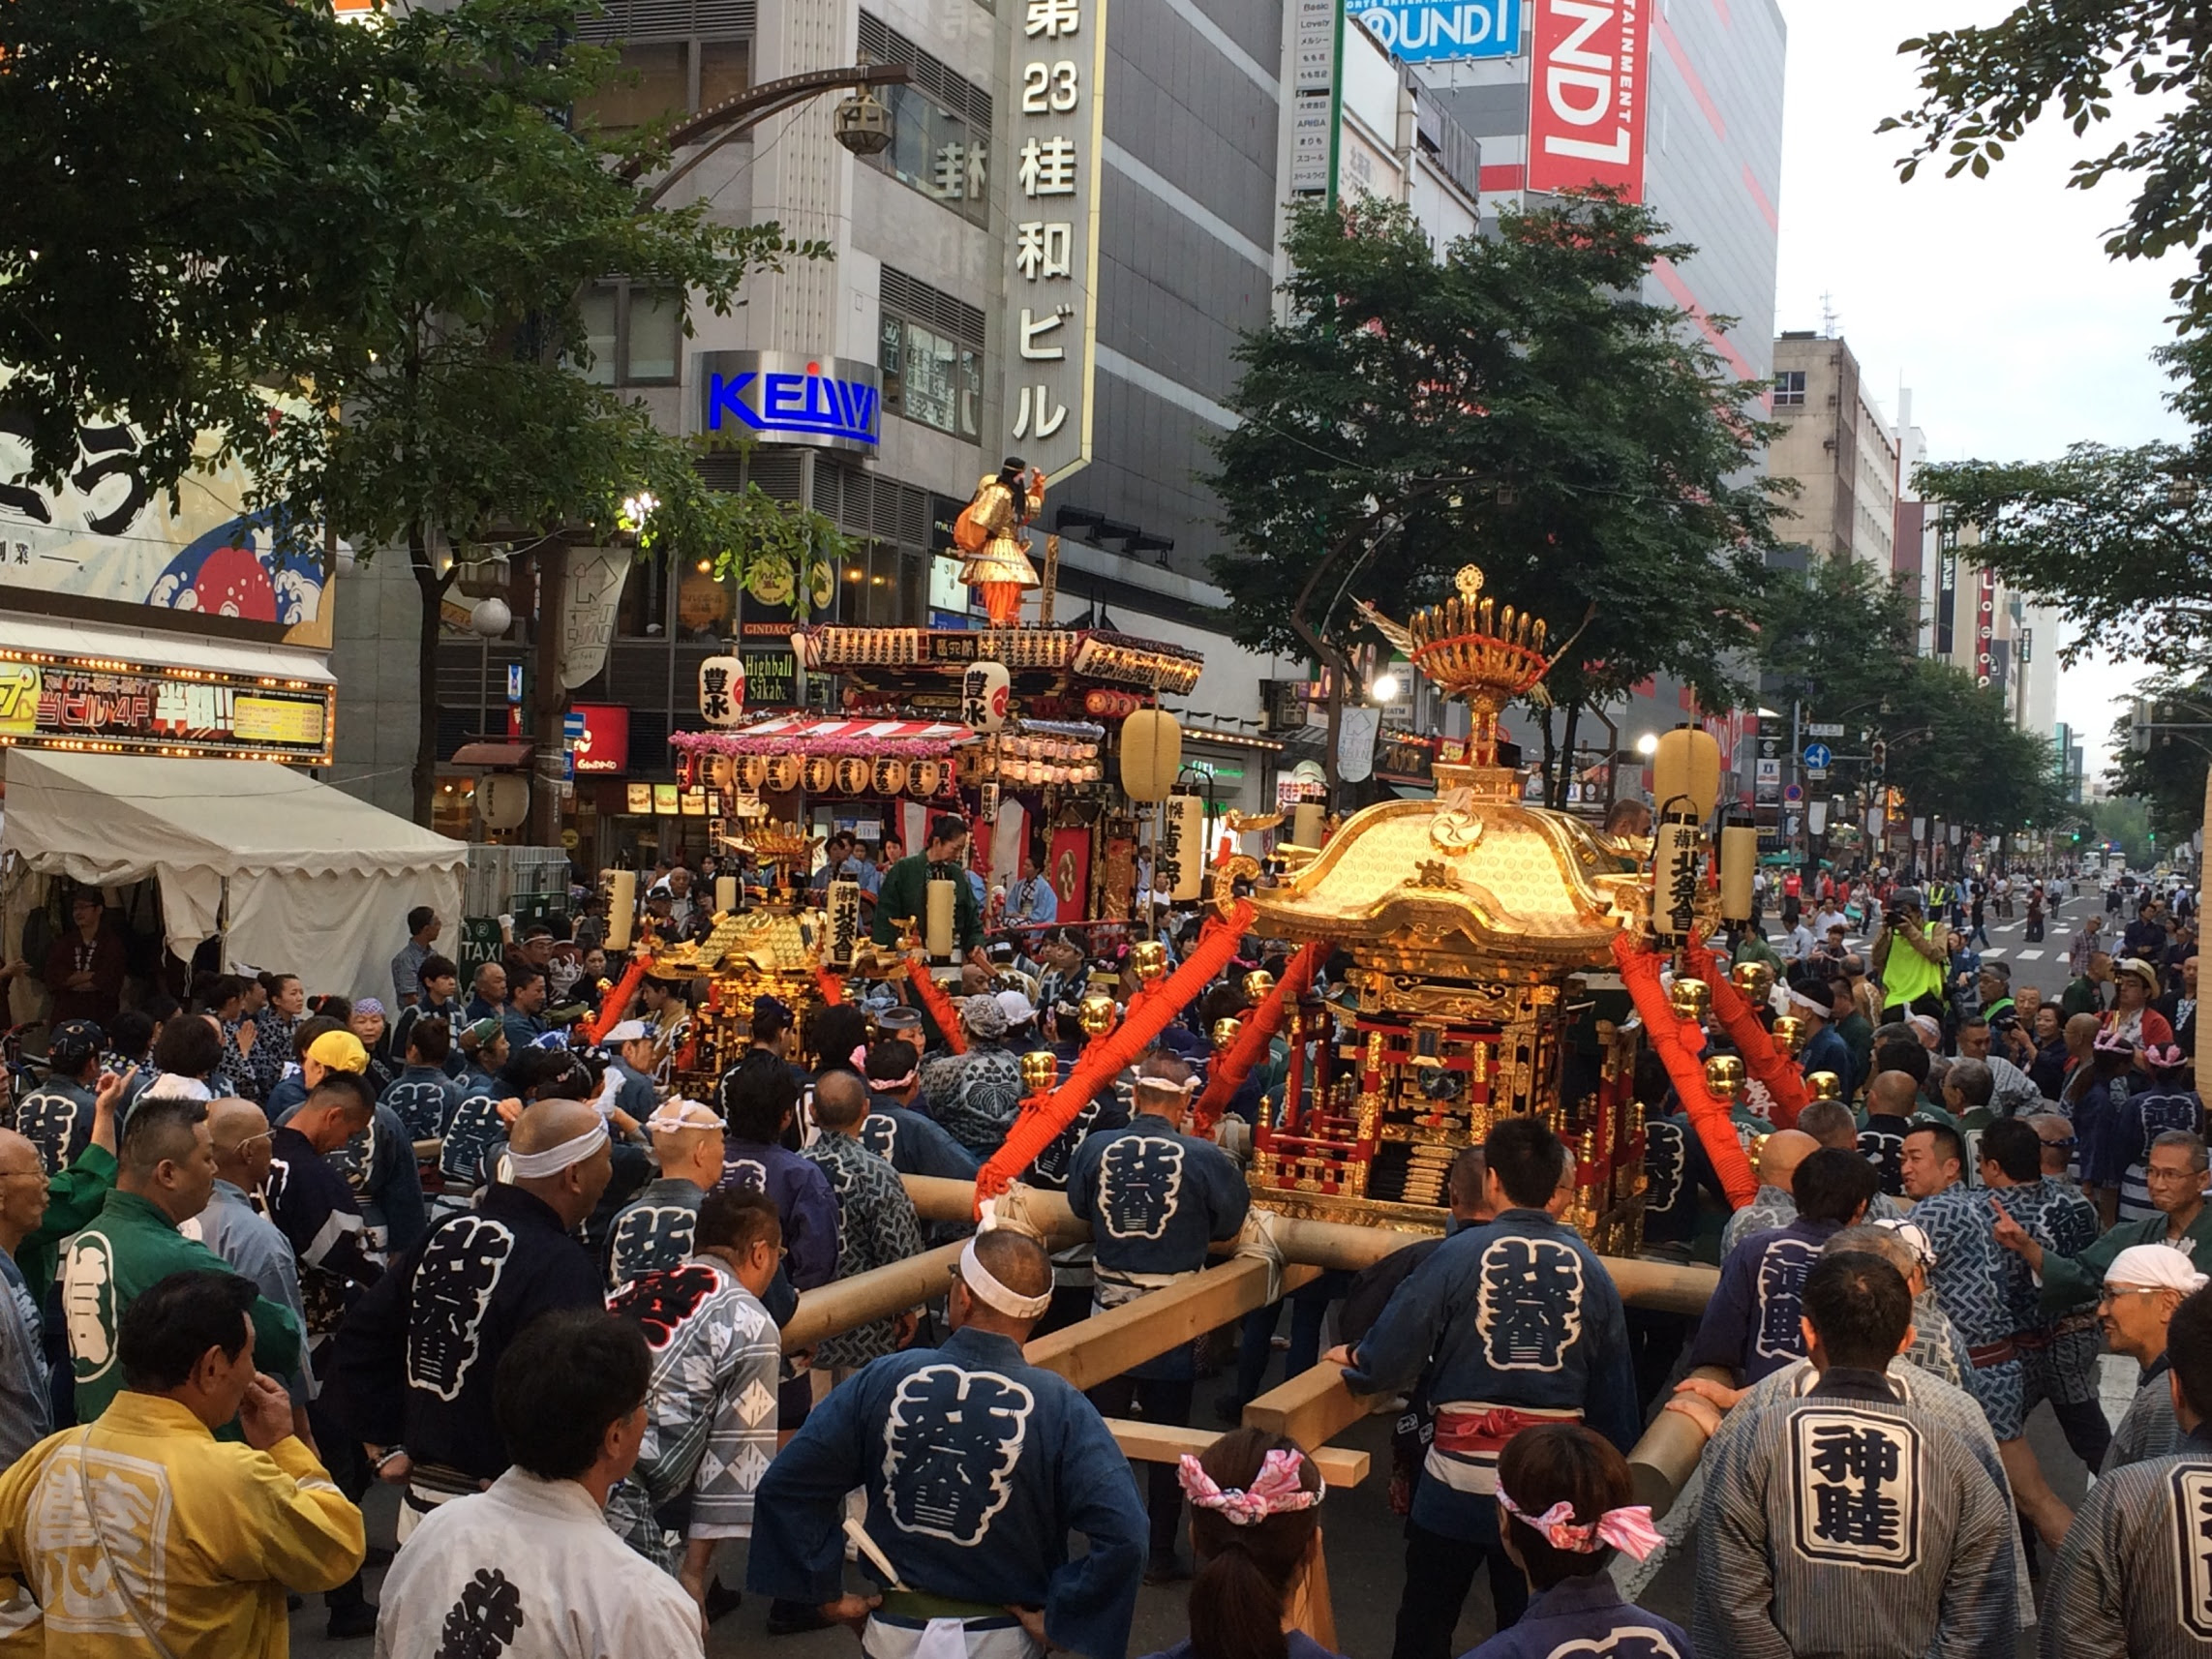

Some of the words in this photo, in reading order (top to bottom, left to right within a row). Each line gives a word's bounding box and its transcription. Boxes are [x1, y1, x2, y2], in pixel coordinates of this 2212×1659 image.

[1544, 0, 1632, 166] ND1
[1300, 137, 1322, 146] まりも
[745, 654, 793, 683] Highball
[462, 941, 503, 962] TAXI
[1811, 1425, 1901, 1553] 神睦
